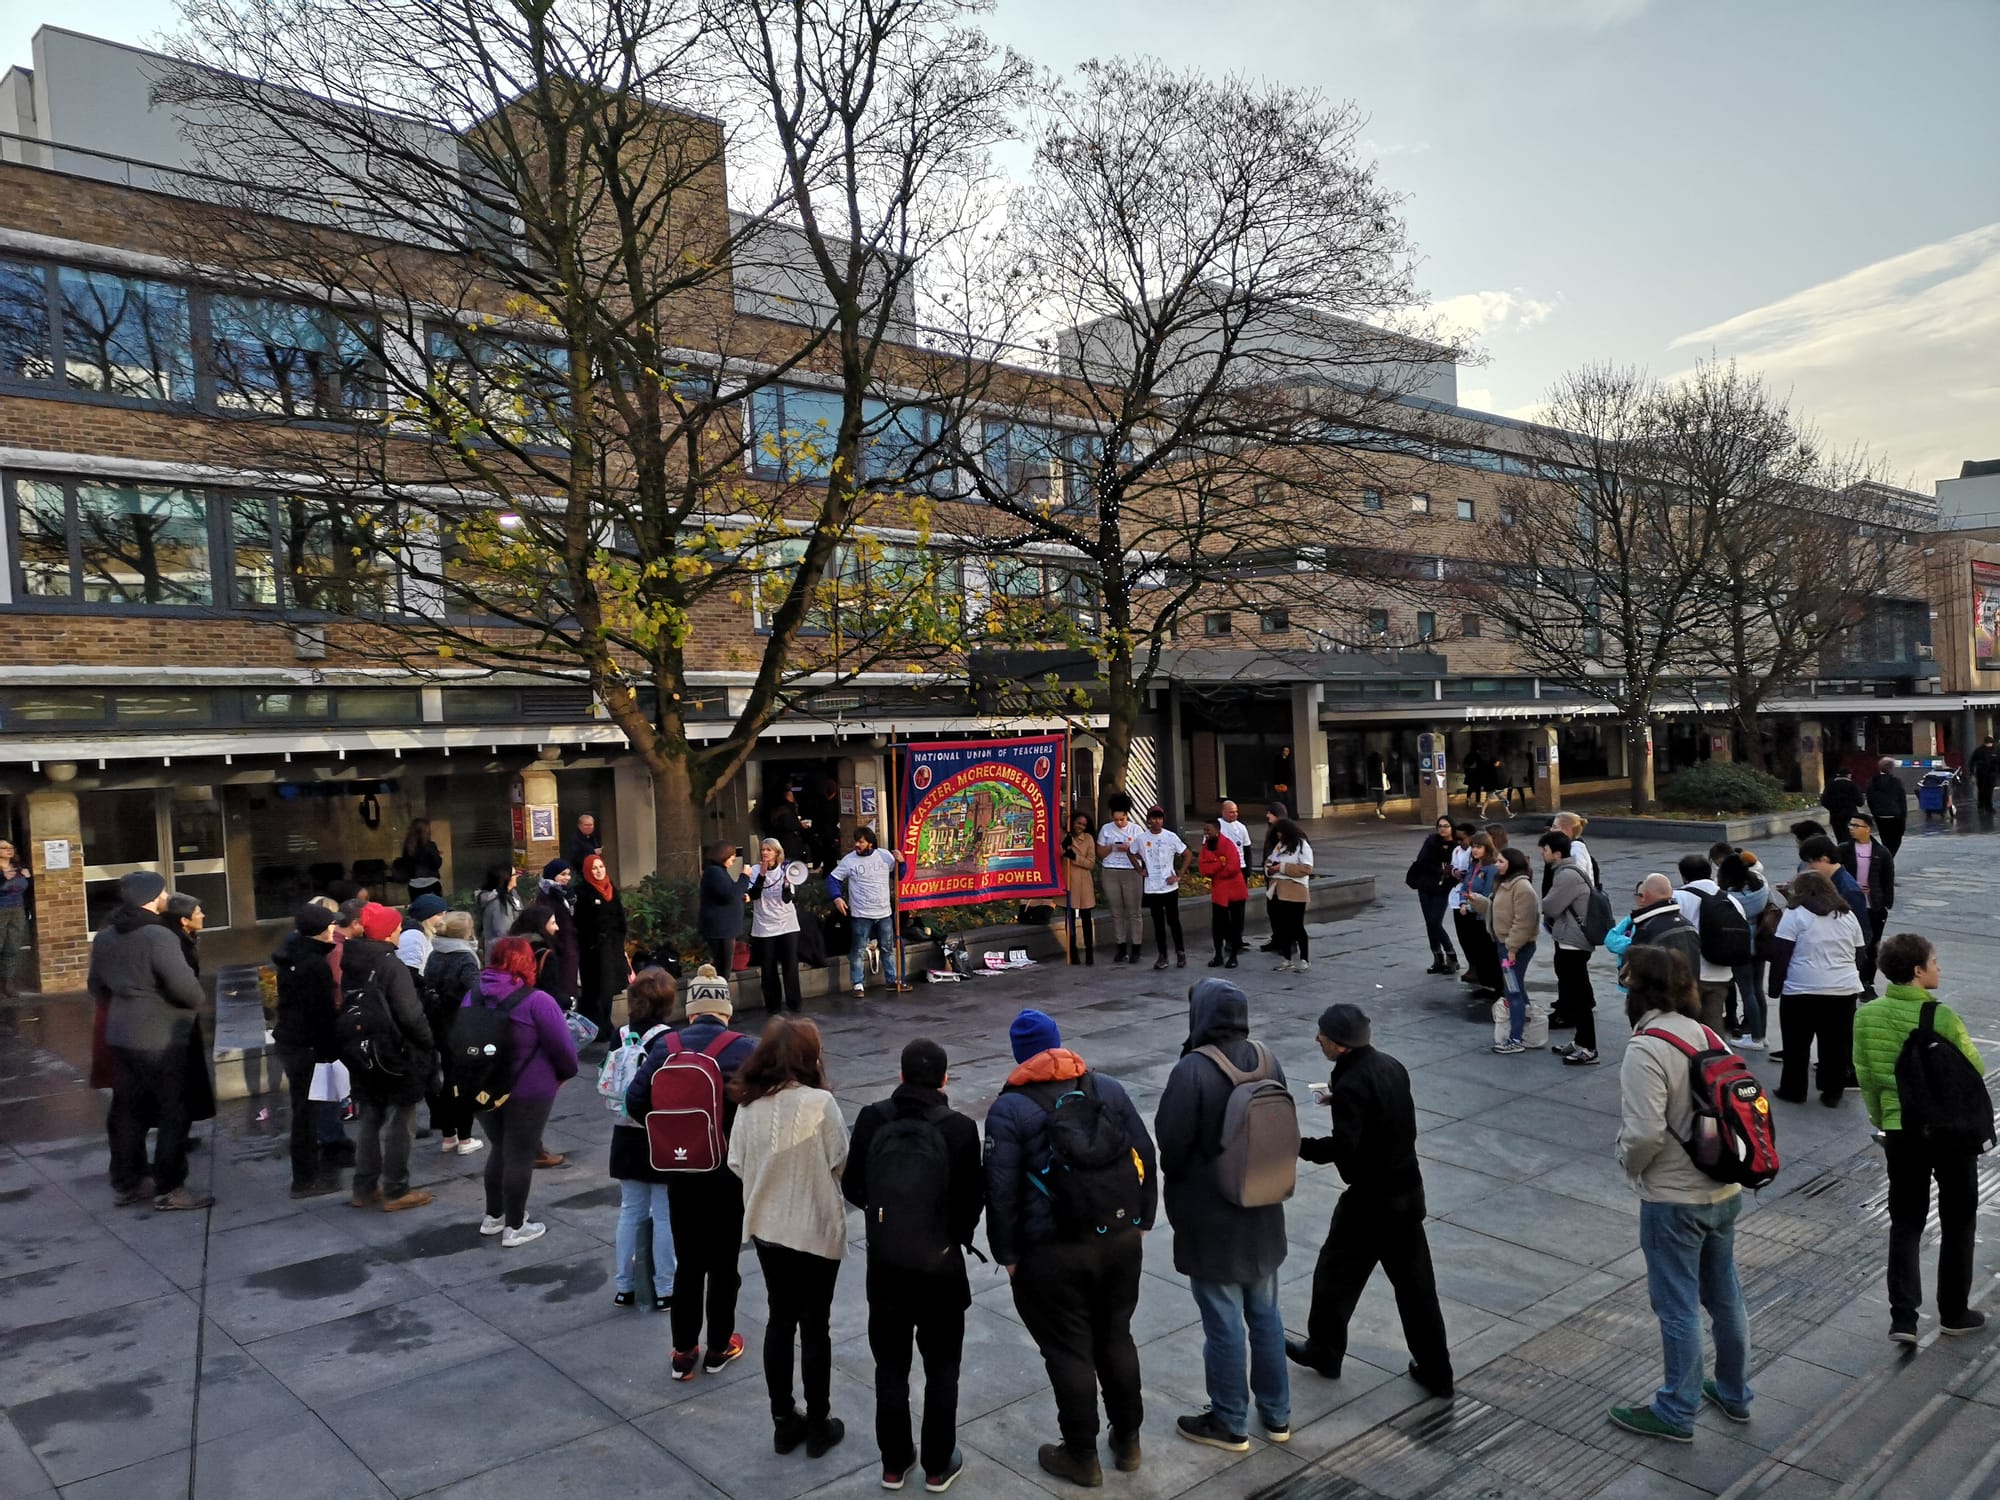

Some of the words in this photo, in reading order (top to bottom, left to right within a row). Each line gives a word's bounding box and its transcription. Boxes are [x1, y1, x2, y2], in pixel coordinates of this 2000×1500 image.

[914, 751, 960, 762] NATIONAL
[966, 750, 992, 760] UNION
[998, 748, 1007, 757] OF
[1013, 744, 1053, 756] TEACHERS
[957, 765, 1023, 786] MORECAMBE
[1021, 777, 1029, 789] &
[1027, 782, 1046, 843] DISTRICT
[901, 877, 974, 895] KNOWLEDGE
[981, 873, 989, 888] IS
[997, 871, 1042, 884] POWER
[691, 986, 730, 1000] VANS
